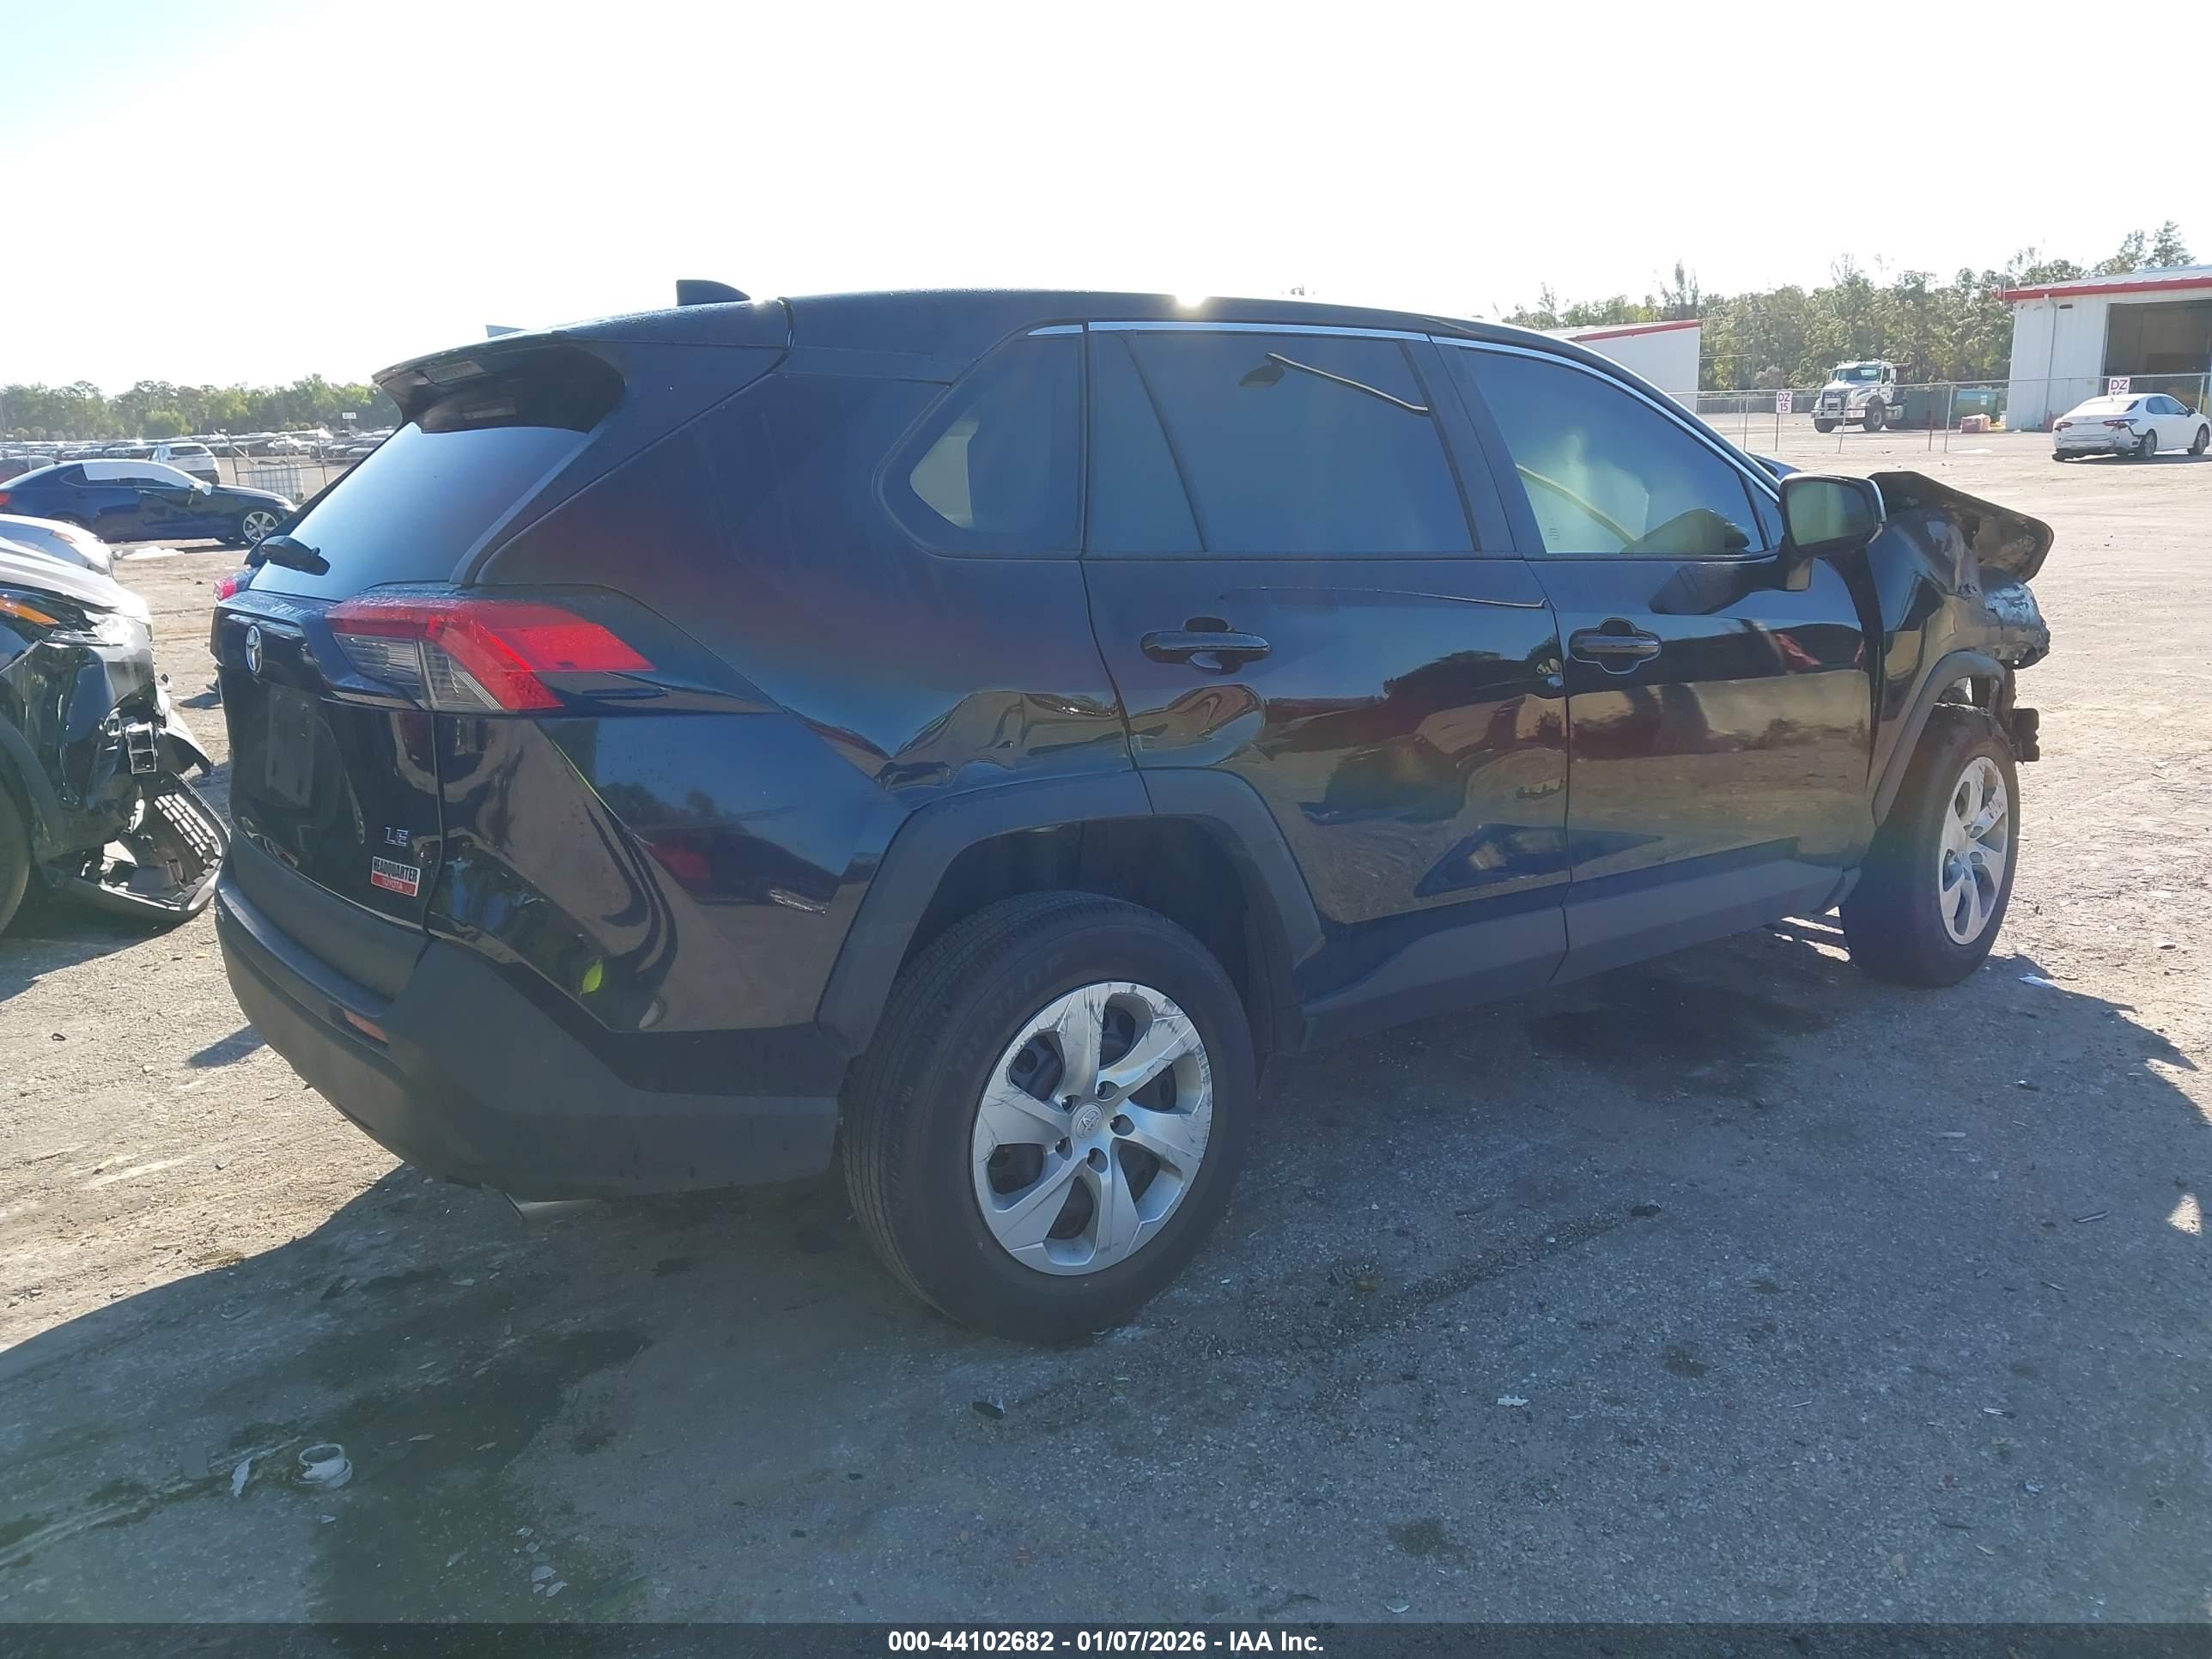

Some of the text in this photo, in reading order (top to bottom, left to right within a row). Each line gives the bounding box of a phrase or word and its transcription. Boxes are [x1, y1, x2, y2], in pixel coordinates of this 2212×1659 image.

[2111, 380, 2128, 390] DZ
[1778, 392, 1790, 402] DZ
[1780, 403, 1789, 411] 15
[384, 827, 409, 846] LE
[373, 858, 418, 883] HEADQUARTER
